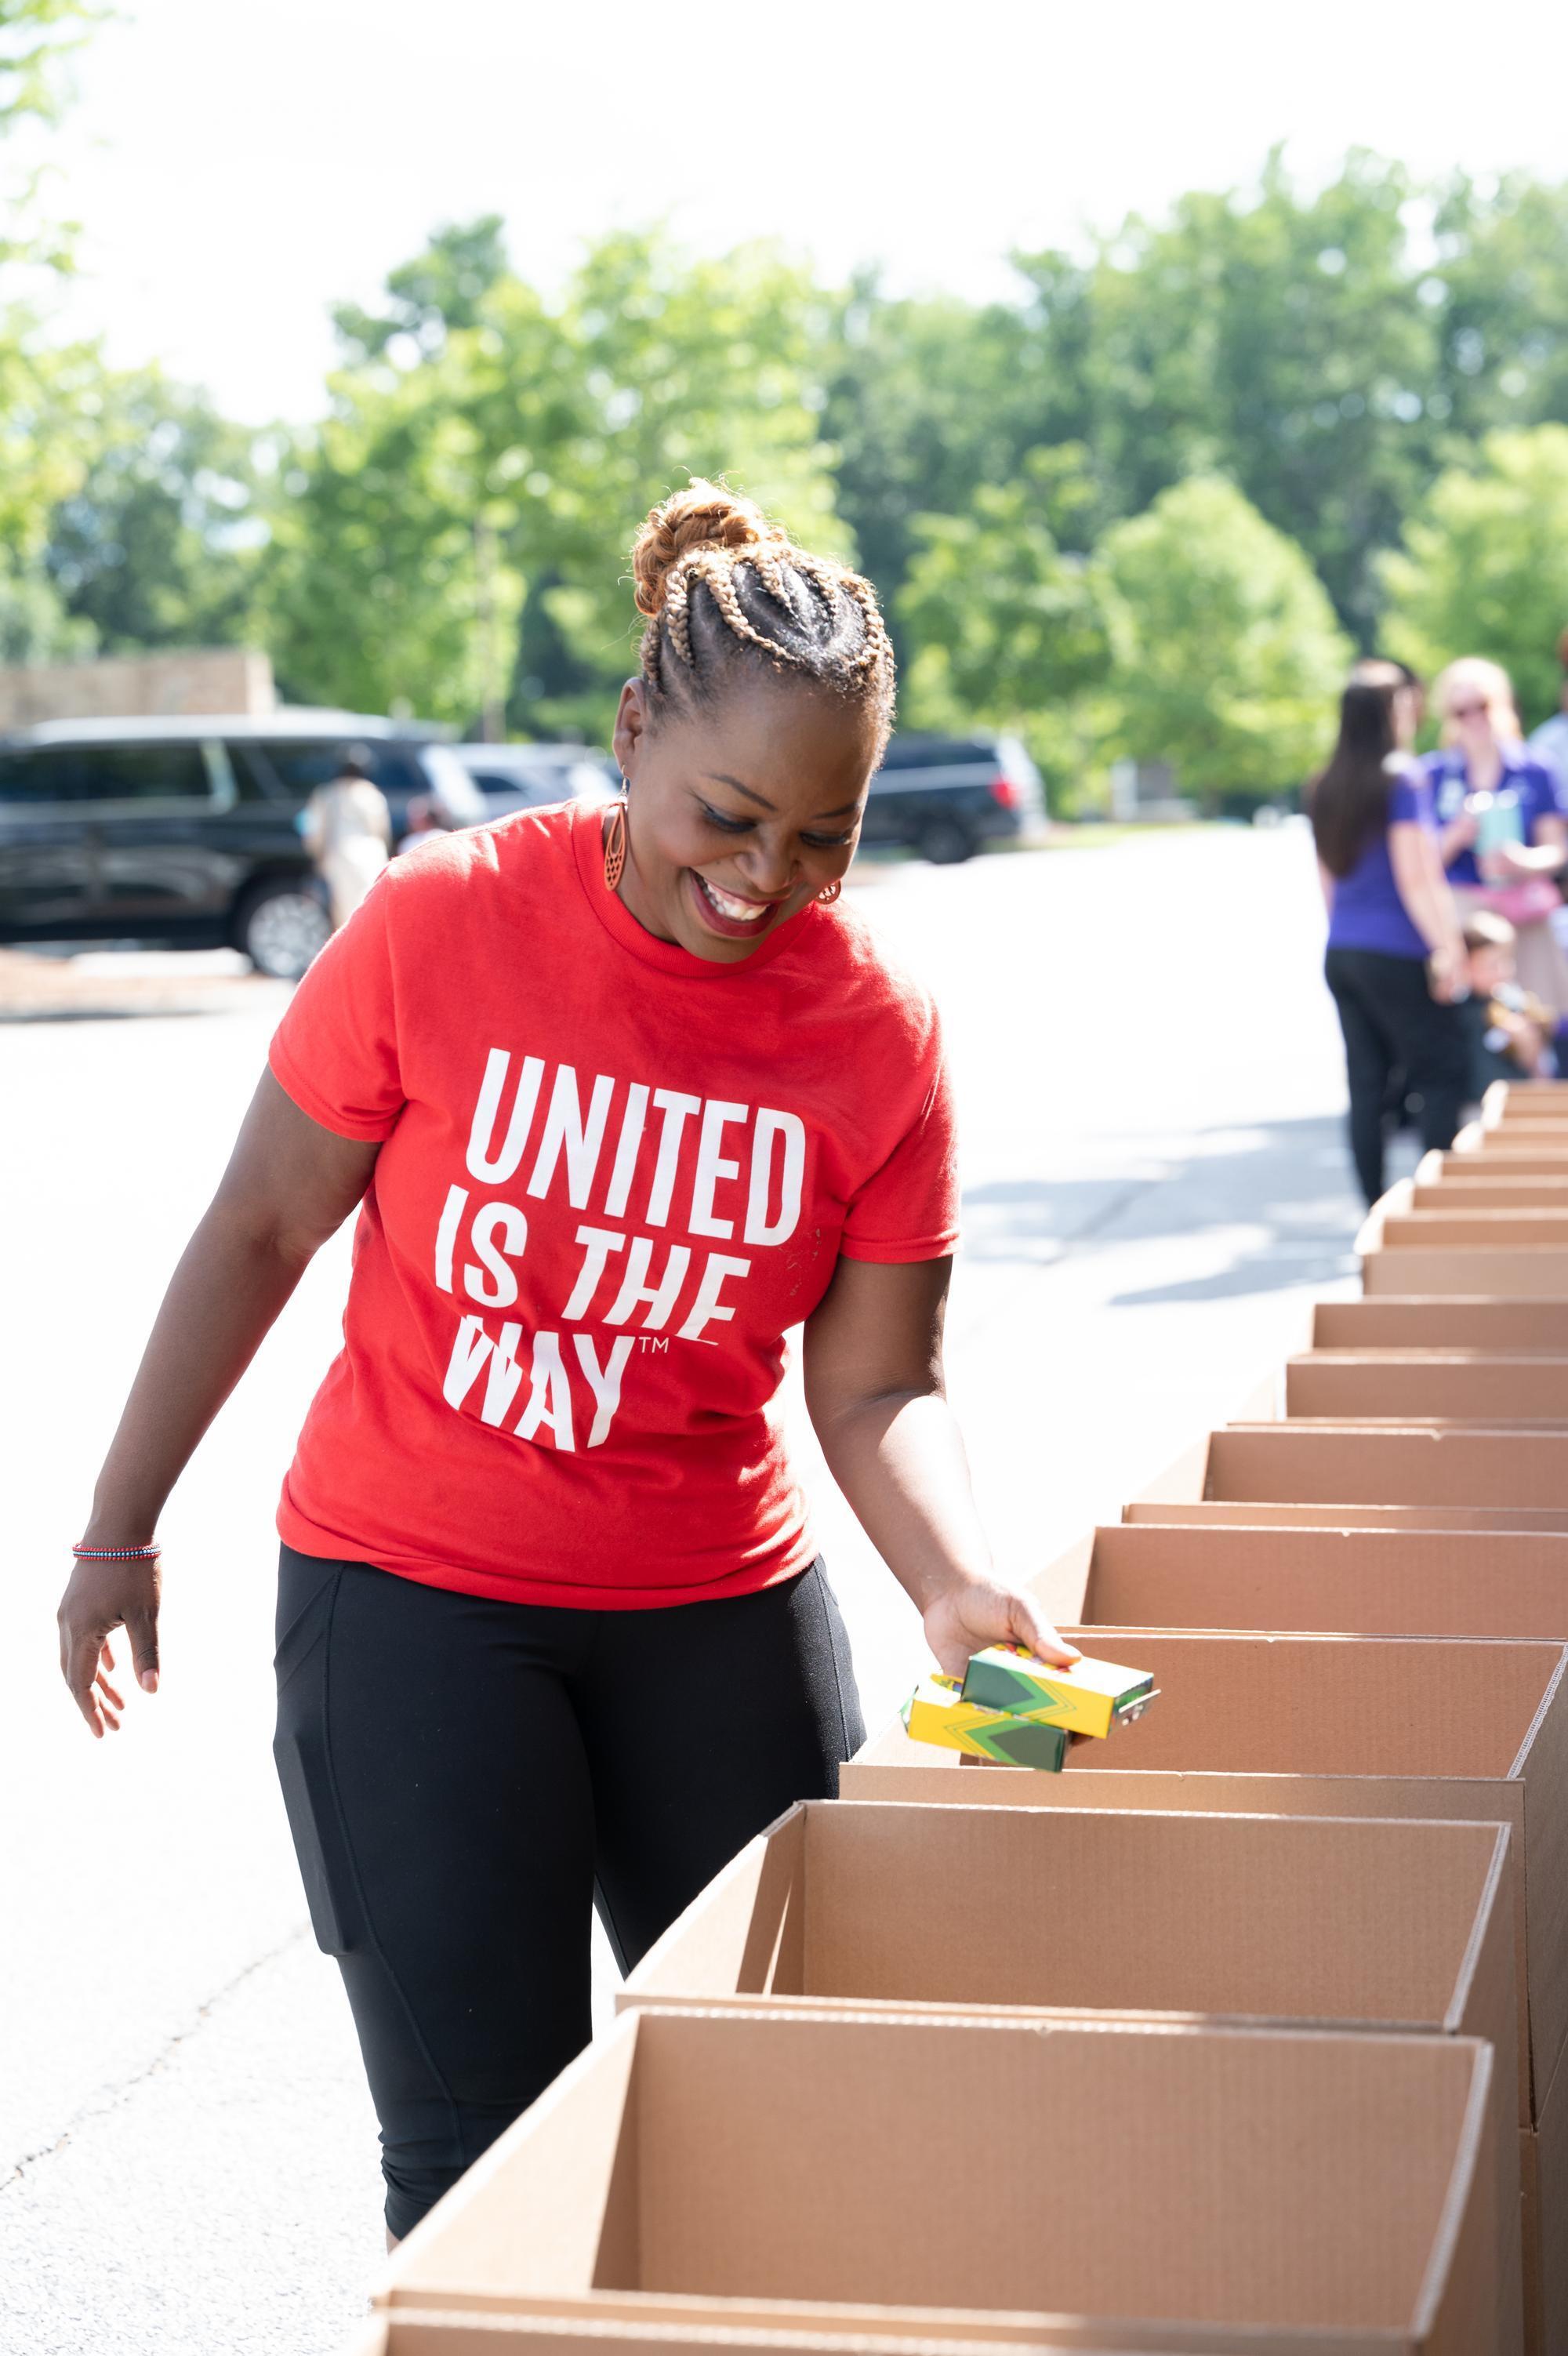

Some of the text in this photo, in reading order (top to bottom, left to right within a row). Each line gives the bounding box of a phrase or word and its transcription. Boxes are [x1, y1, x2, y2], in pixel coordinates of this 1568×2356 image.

[466, 1047, 806, 1246] UNITED
[434, 1184, 752, 1345] IS THE
